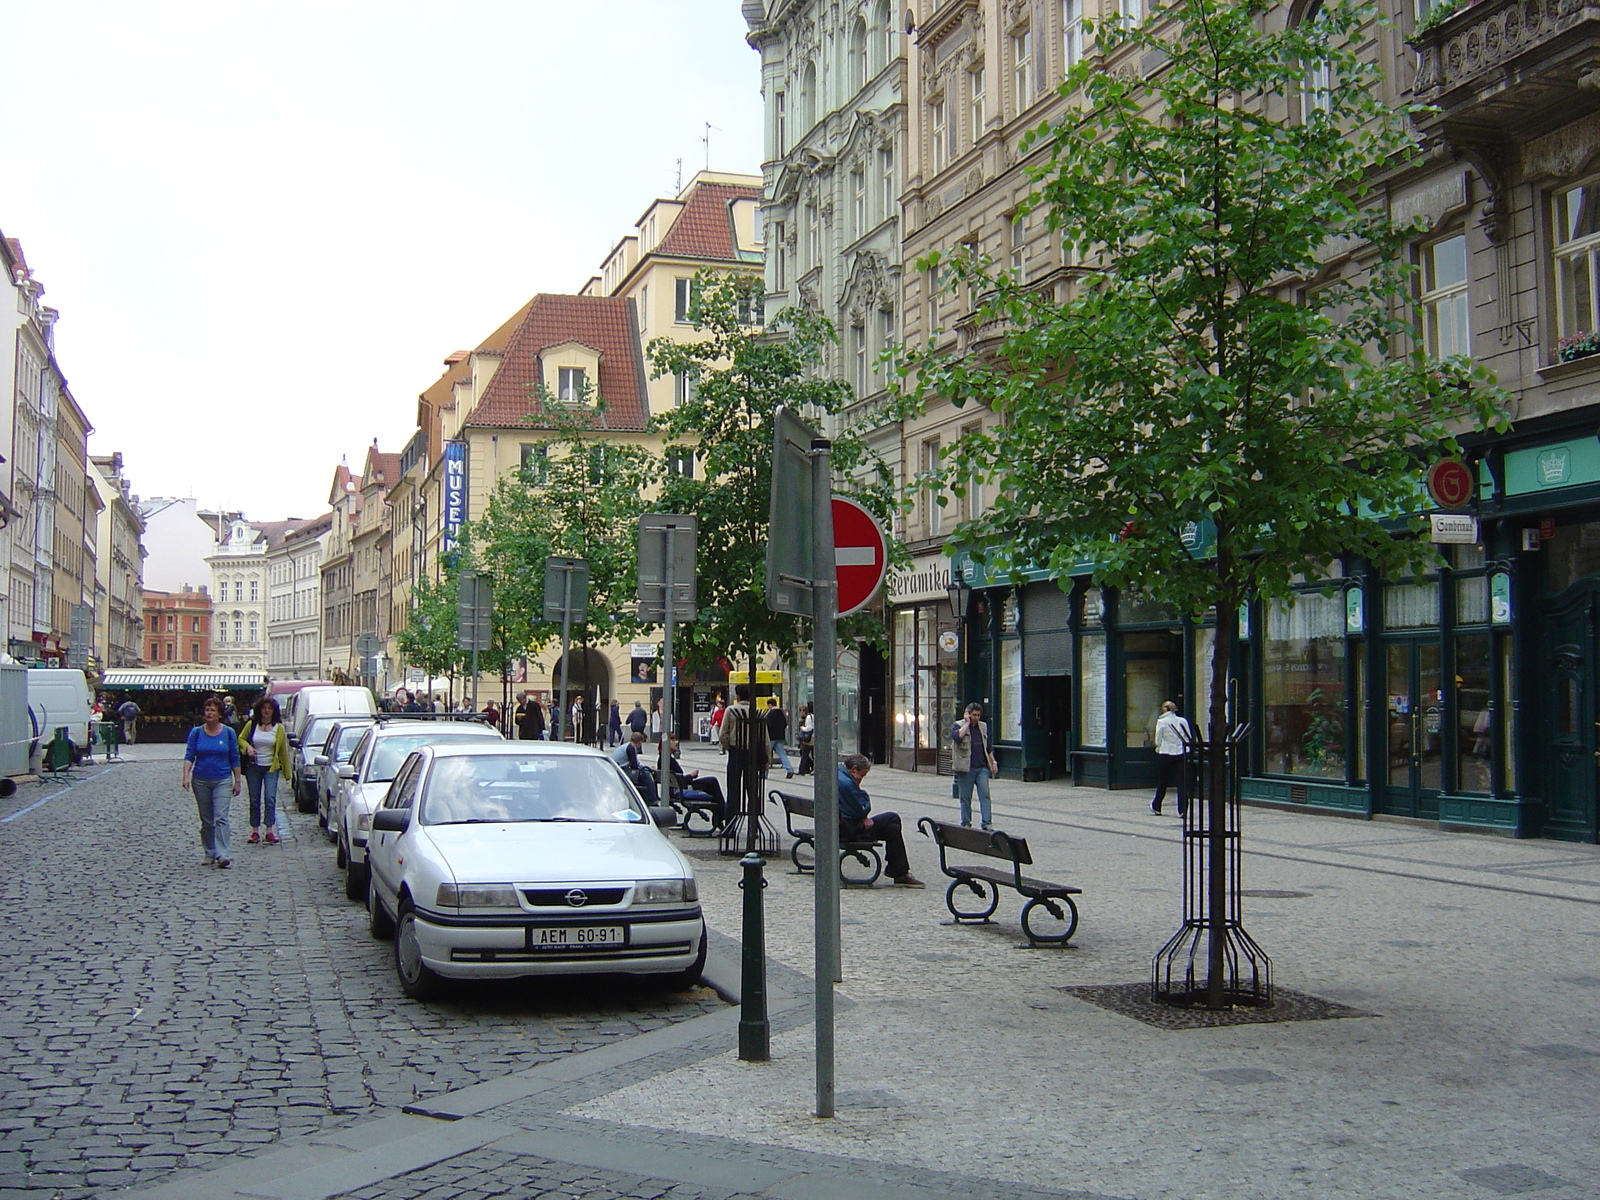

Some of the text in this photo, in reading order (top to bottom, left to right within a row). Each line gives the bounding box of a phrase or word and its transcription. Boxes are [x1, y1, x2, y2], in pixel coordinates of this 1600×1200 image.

[447, 459, 464, 555] MUSEUM
[1436, 518, 1473, 532] Gambrinus
[541, 928, 616, 944] AEM 60-91
